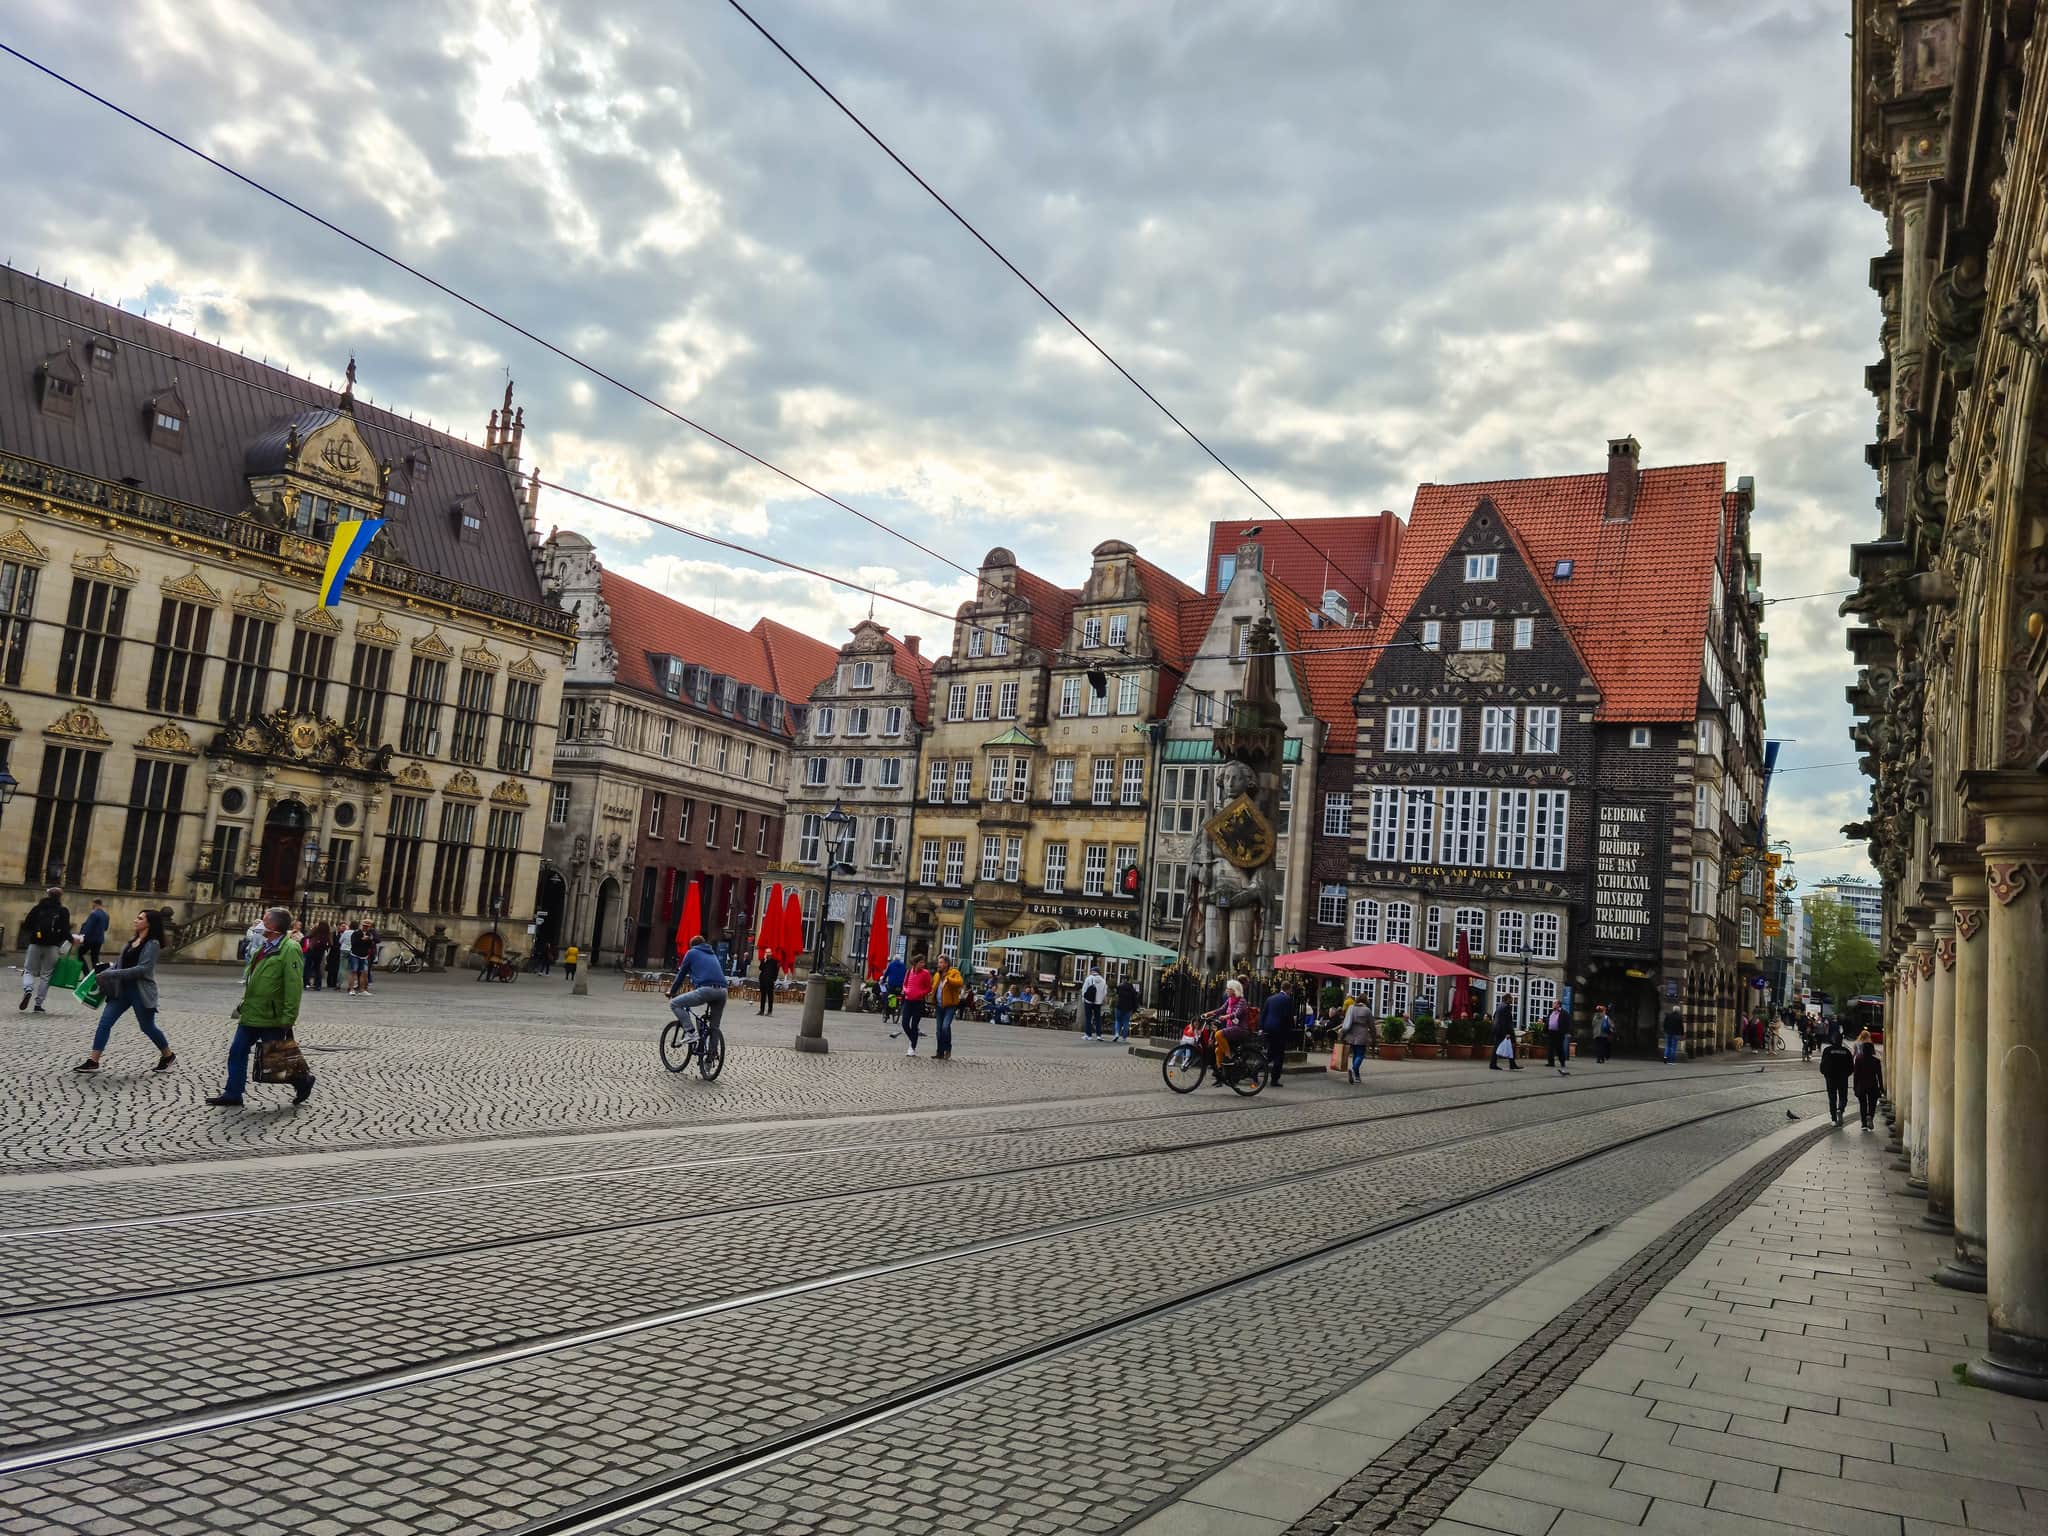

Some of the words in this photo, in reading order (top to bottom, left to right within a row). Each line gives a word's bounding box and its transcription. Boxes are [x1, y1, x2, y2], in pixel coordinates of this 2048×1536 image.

[1600, 807, 1647, 822] GEDENKE
[1599, 823, 1620, 838] DER
[1599, 839, 1645, 857] BRÜDER,
[1598, 857, 1615, 872] DIE
[1618, 858, 1637, 873] DAS
[1450, 868, 1467, 878] AM
[1472, 870, 1512, 879] MARKT
[1597, 874, 1651, 890] SCHICKSAL
[1596, 891, 1643, 907] UNSERER
[1033, 904, 1063, 915] RATHS
[1077, 908, 1129, 919] APOTHEKE
[1595, 907, 1650, 925] TRENNUNG
